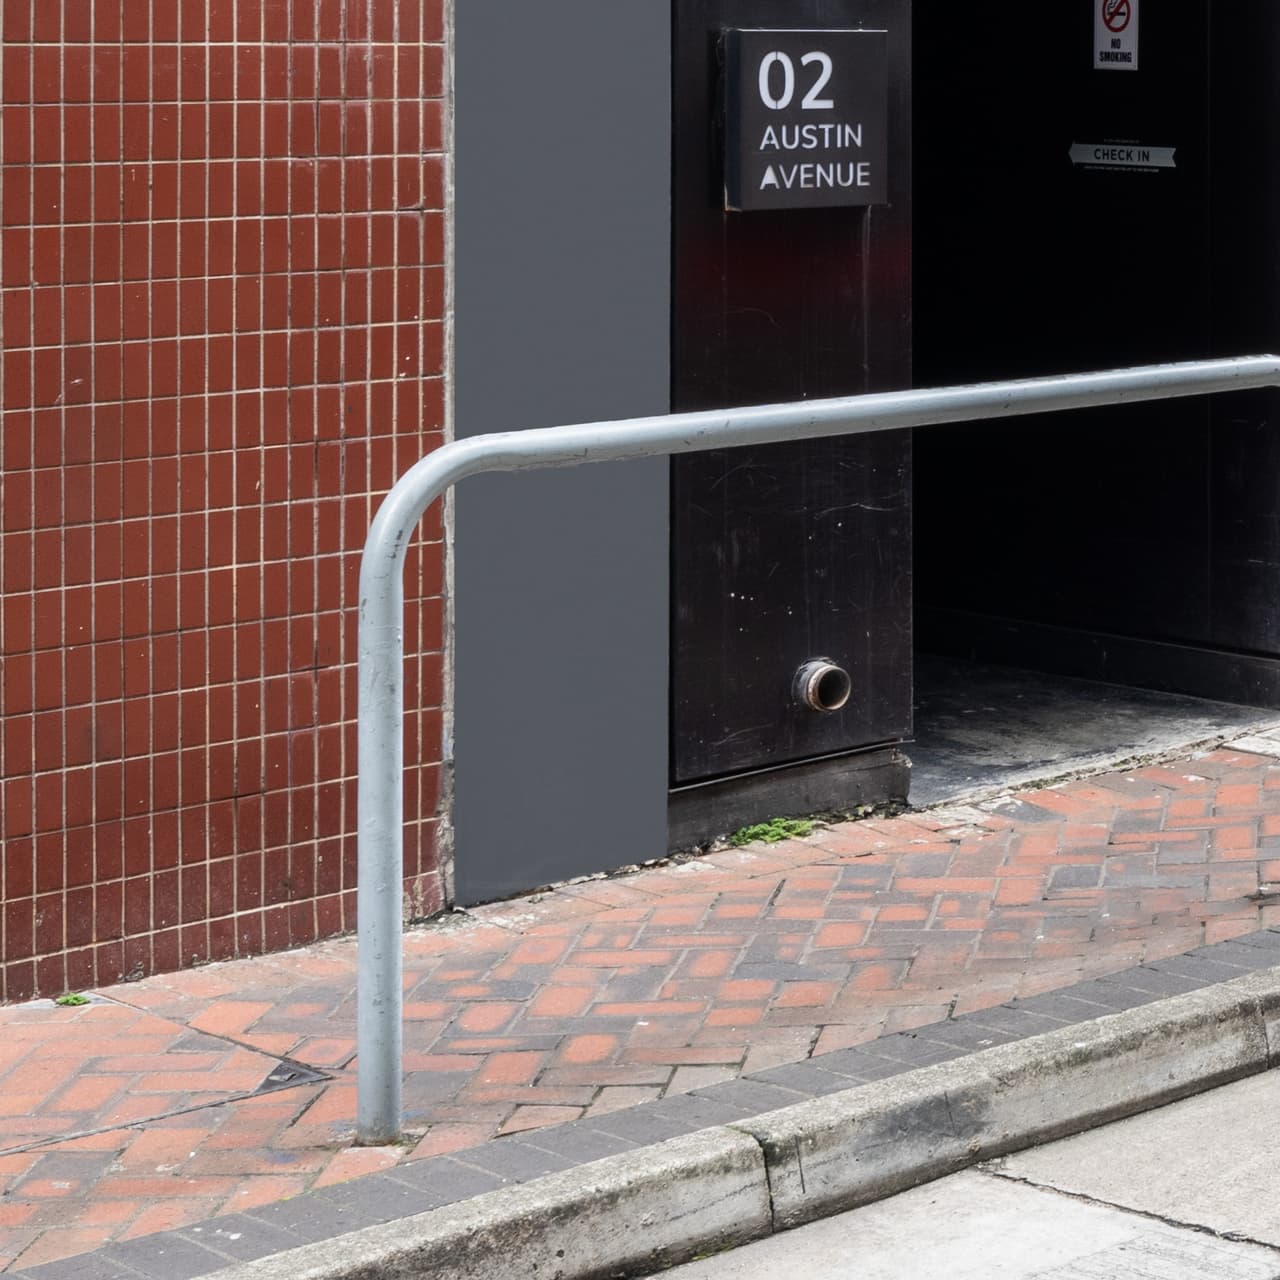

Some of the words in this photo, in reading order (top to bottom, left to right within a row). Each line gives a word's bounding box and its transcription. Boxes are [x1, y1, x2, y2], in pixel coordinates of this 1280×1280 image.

[1111, 38, 1121, 49] NO
[1099, 51, 1132, 63] SMOKING
[758, 50, 834, 110] 02
[760, 123, 862, 151] AUSTIN
[1094, 148, 1134, 161] CHECK
[1137, 150, 1150, 162] IN
[760, 162, 871, 190] AVENUE
